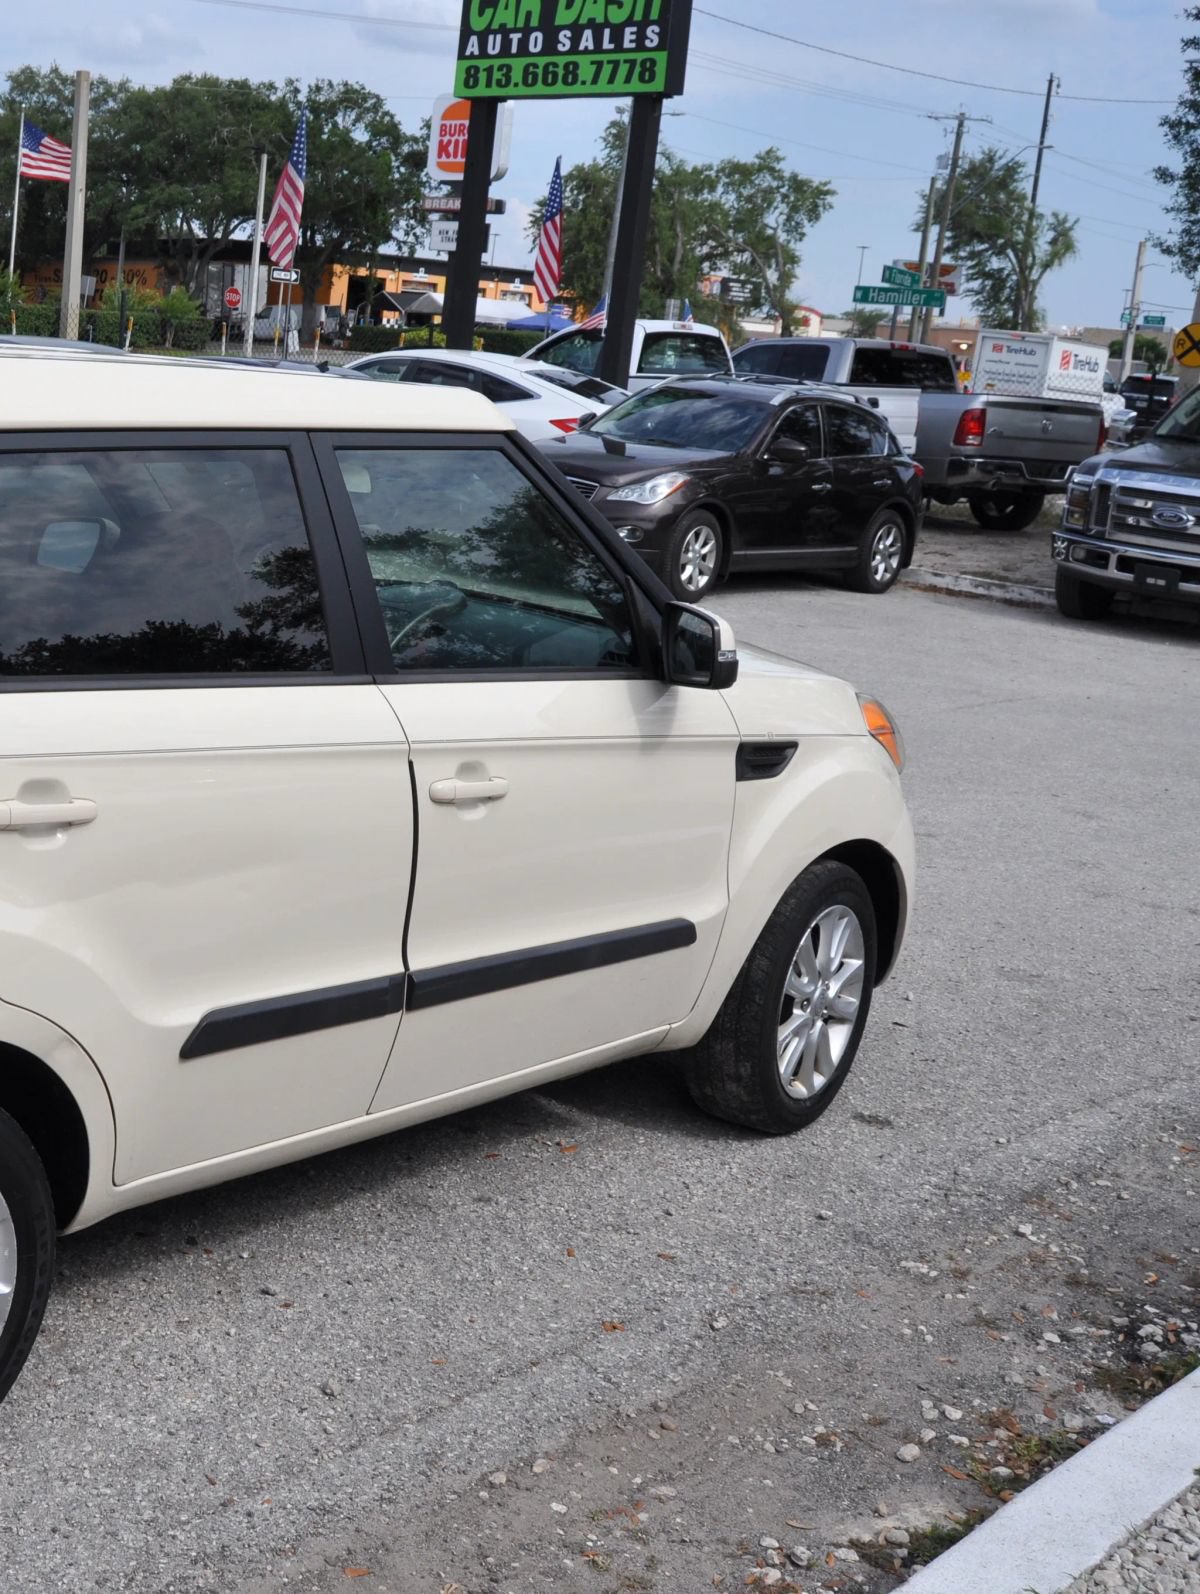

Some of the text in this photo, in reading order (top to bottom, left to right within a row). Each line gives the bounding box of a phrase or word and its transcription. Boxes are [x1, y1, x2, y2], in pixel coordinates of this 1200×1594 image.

[464, 25, 661, 56] AUTO SALES
[463, 57, 658, 90] 813.668.7778
[439, 122, 469, 138] BUR
[437, 138, 468, 159] KI
[225, 292, 241, 301] STOP
[868, 287, 927, 305] Hamiller
[1006, 345, 1037, 357] TireHub
[1177, 338, 1185, 349] R
[1073, 353, 1099, 373] TireHub
